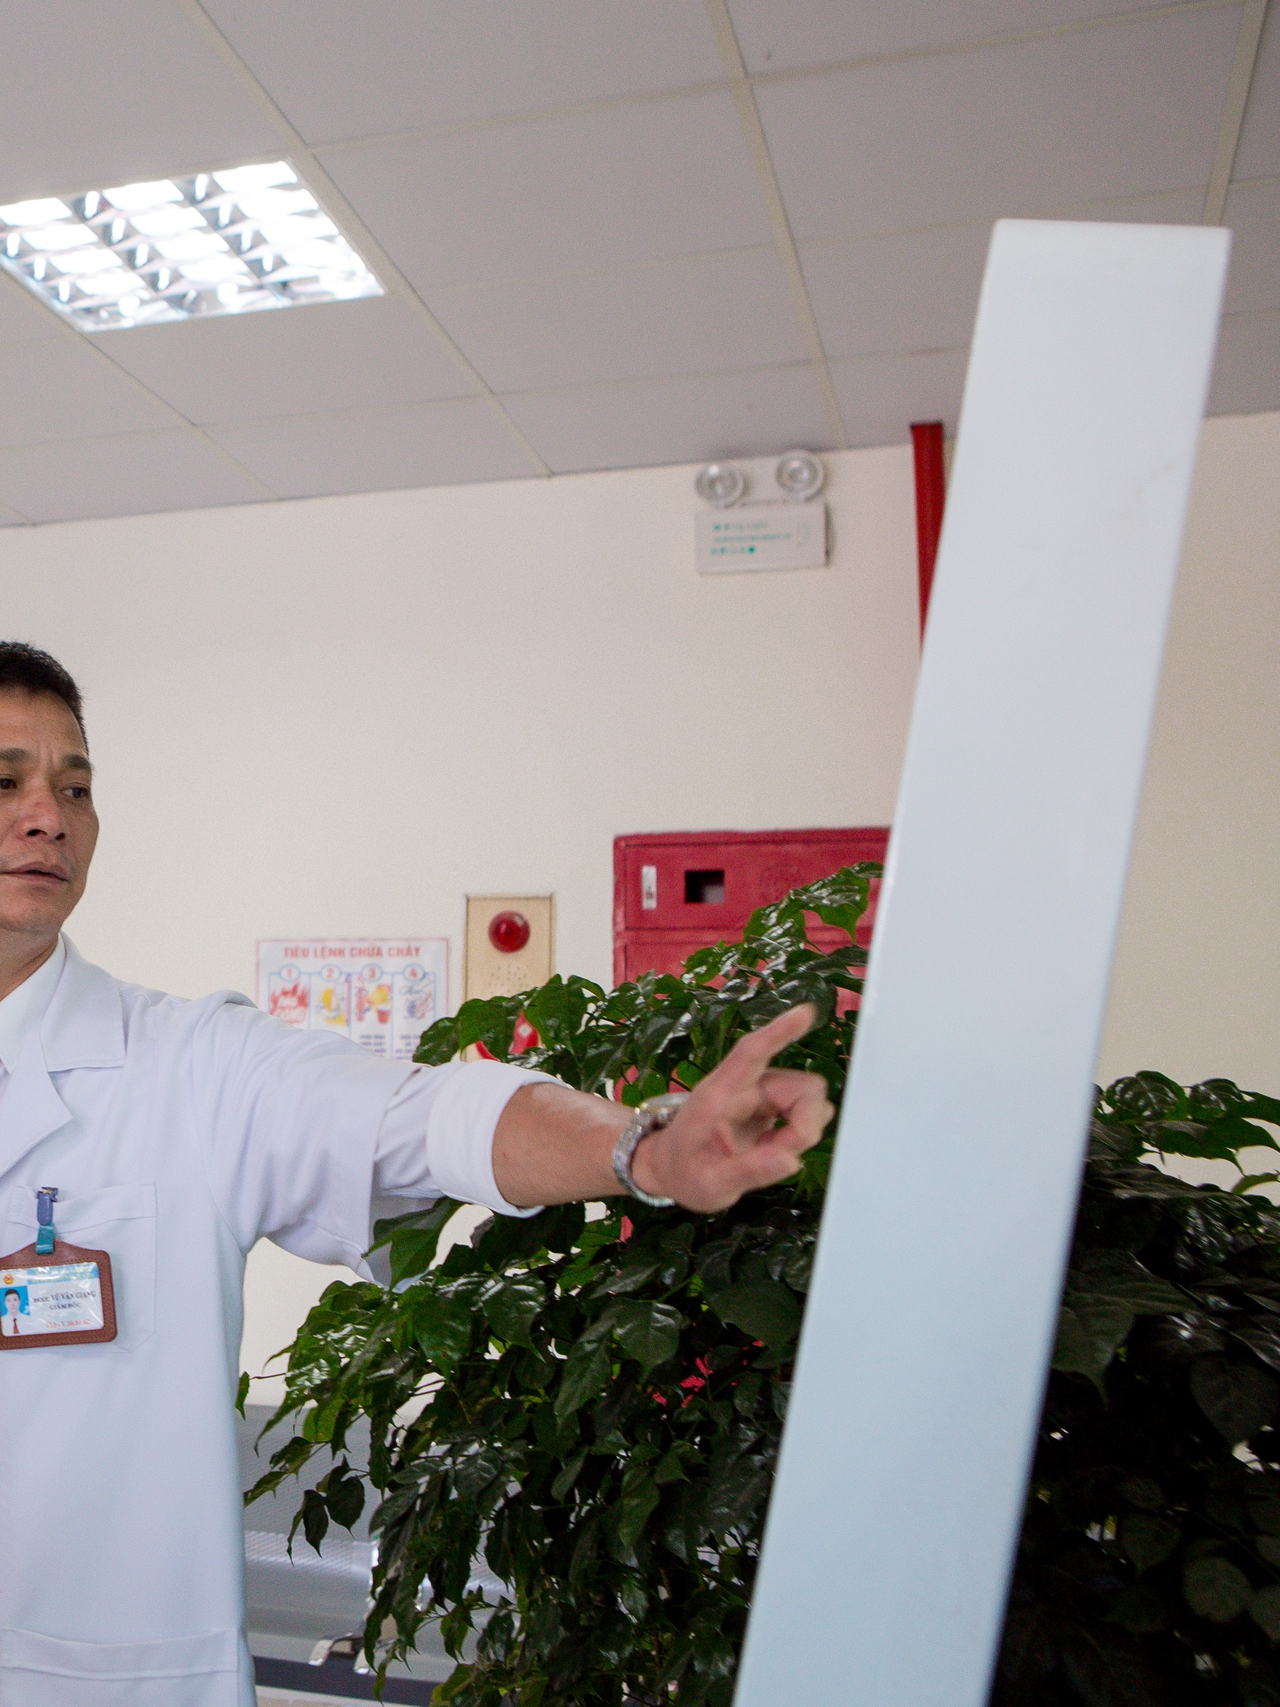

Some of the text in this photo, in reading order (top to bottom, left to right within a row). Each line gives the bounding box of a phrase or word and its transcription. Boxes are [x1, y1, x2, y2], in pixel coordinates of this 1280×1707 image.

[327, 967, 334, 979] 2
[369, 967, 376, 979] 3
[410, 967, 418, 979] 4
